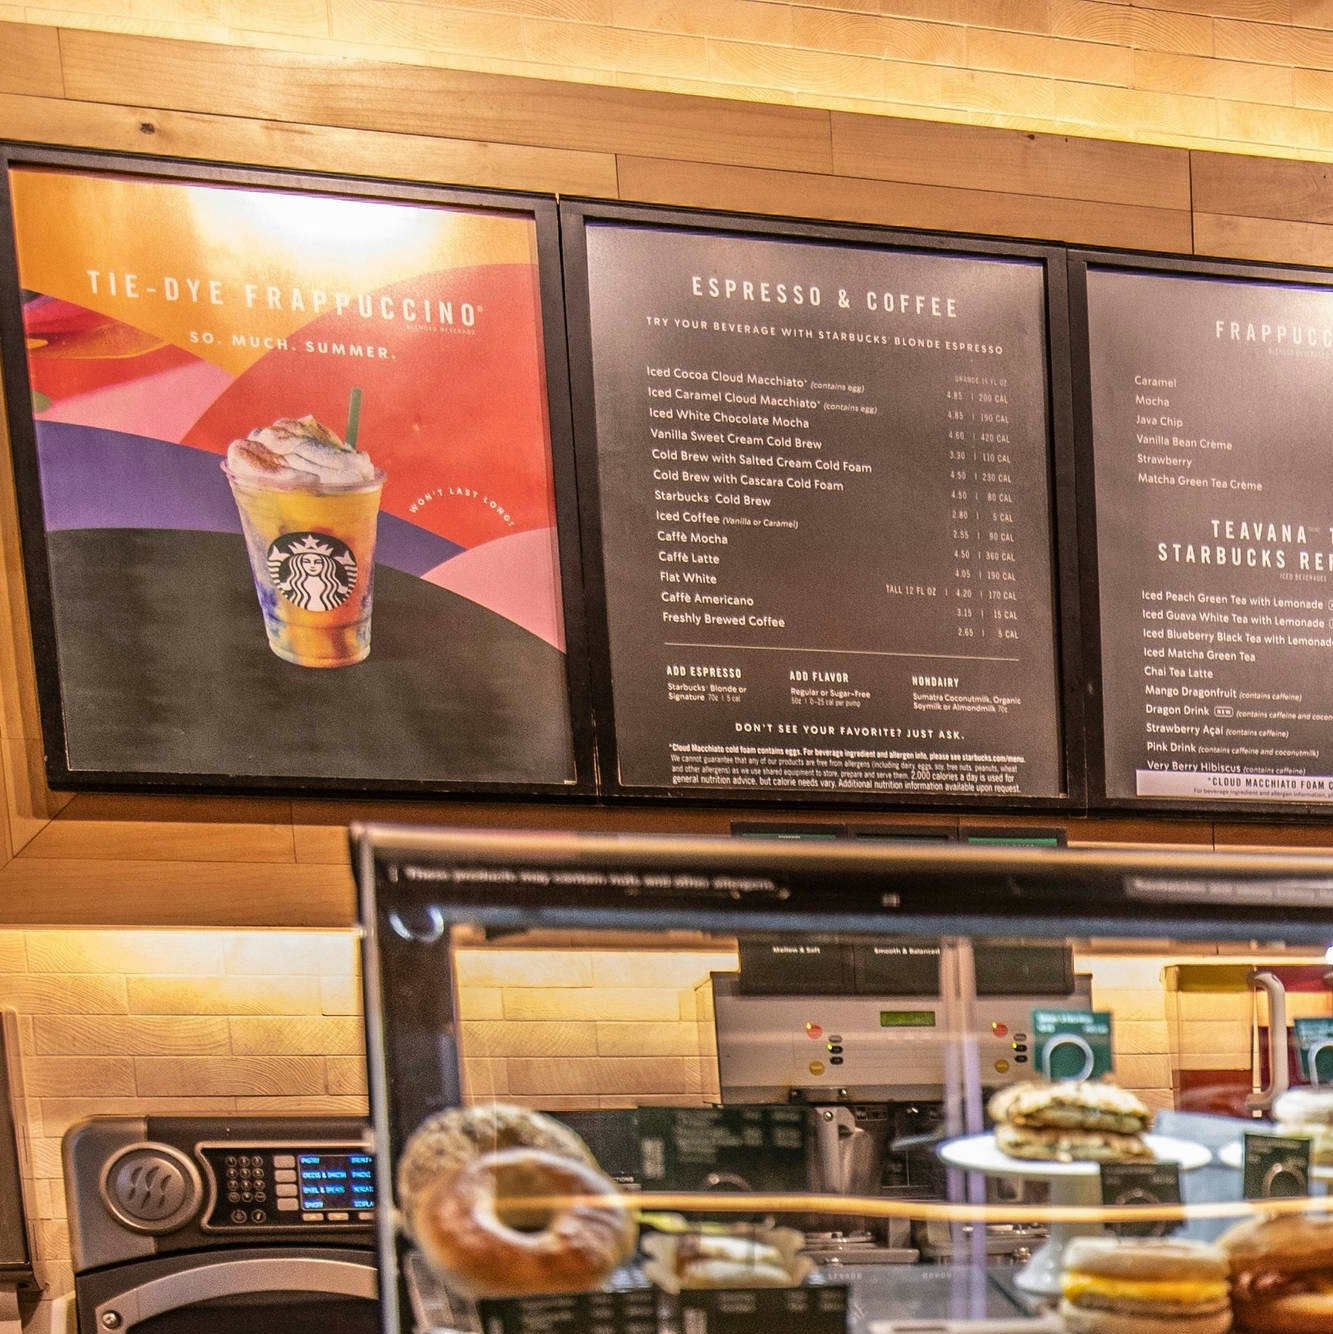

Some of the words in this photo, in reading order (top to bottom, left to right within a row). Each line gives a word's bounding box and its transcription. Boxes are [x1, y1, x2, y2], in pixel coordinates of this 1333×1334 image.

[86, 269, 224, 305] TIE-DYE
[246, 282, 477, 326] FRAPPUCCINO
[691, 275, 820, 305] ESPRESSO
[837, 288, 850, 308] &
[866, 290, 956, 317] COFFEE
[645, 315, 668, 326] TRY
[673, 318, 707, 329] YOUR
[712, 321, 775, 335] BEVERAGE
[780, 327, 812, 338] WITH
[893, 336, 940, 349] BLONDE
[944, 340, 1003, 354] ESPRESSO
[189, 330, 222, 344] SO.
[231, 333, 296, 351] MUCH.
[304, 340, 396, 360] SUMMER.
[646, 364, 670, 377] Iced
[673, 367, 708, 380] Cocoa
[711, 370, 743, 383] Cloud
[1134, 374, 1176, 387] Caramel
[647, 386, 672, 398] Iced
[674, 388, 721, 401] Caramel
[724, 391, 756, 404] Cloud
[1135, 394, 1169, 407] Mocha
[649, 407, 673, 418] Iced
[675, 408, 710, 421] White
[712, 411, 769, 425] Chocolate
[772, 415, 809, 428] Mocha
[1135, 414, 1157, 425] Java
[1159, 416, 1183, 428] Chip
[650, 427, 687, 440] Vanilla
[690, 430, 724, 443] Sweet
[727, 432, 763, 445] Cream
[766, 435, 791, 447] Cold
[794, 437, 822, 449] Brew
[1136, 433, 1169, 445] Vanilla
[1171, 436, 1197, 447] Bean
[1199, 437, 1232, 450] Crème
[651, 448, 677, 460] Cold
[680, 450, 708, 462] Brew
[711, 452, 736, 463] with
[738, 454, 773, 466] Salted
[776, 456, 812, 468] Cream
[814, 458, 839, 470] Cold
[842, 461, 872, 472] Foam
[1137, 453, 1192, 468] Strawberry
[652, 468, 678, 480] Cold
[681, 470, 710, 482] Brew
[712, 473, 737, 484] with
[739, 474, 783, 487] Cascara
[785, 477, 811, 488] Cold
[814, 479, 843, 490] Foam
[1138, 472, 1175, 484] Matcha
[1177, 474, 1208, 486] Green
[1210, 477, 1227, 488] Tea
[1229, 479, 1262, 491] Crème
[714, 492, 740, 504] Cold
[743, 494, 771, 506] Brew
[655, 509, 679, 521] Iced
[682, 511, 720, 523] Coffee
[656, 530, 687, 542] Caffè
[690, 532, 728, 544] Mocha
[658, 550, 688, 562] Caffè
[691, 552, 719, 564] Latte
[1157, 542, 1285, 568] STARBUCKS
[659, 570, 680, 582] Flat
[682, 572, 717, 584] White
[660, 591, 691, 603] Caffè
[694, 592, 754, 606] Americano
[1141, 589, 1162, 600] Iced
[1165, 590, 1195, 602] Peach
[1197, 592, 1227, 604] Green
[1230, 594, 1246, 605] Tea
[1249, 596, 1270, 606] with
[1273, 596, 1323, 609] Lemonade
[662, 611, 701, 625] Freshly
[703, 613, 745, 625] Brewed
[748, 615, 785, 627] Coffee
[1142, 608, 1163, 619] Iced
[1165, 610, 1196, 621] Guava
[1198, 611, 1229, 623] White
[1231, 613, 1248, 623] Tea
[1250, 615, 1272, 625] with
[1274, 615, 1324, 628] Lemonade
[1142, 627, 1164, 638] Iced
[1166, 628, 1214, 643] Blueberry
[1216, 631, 1242, 642] Black
[1244, 632, 1261, 643] Tea
[1263, 634, 1285, 644] with
[735, 722, 772, 732] DON'T
[777, 723, 797, 733] SEE
[802, 724, 834, 735] YOUR
[839, 726, 901, 737] FAVORITE?
[906, 728, 933, 738] JUST
[938, 729, 964, 739] ASK.
[1245, 778, 1296, 789] MACCHIATO
[1300, 780, 1324, 789] FOAM
